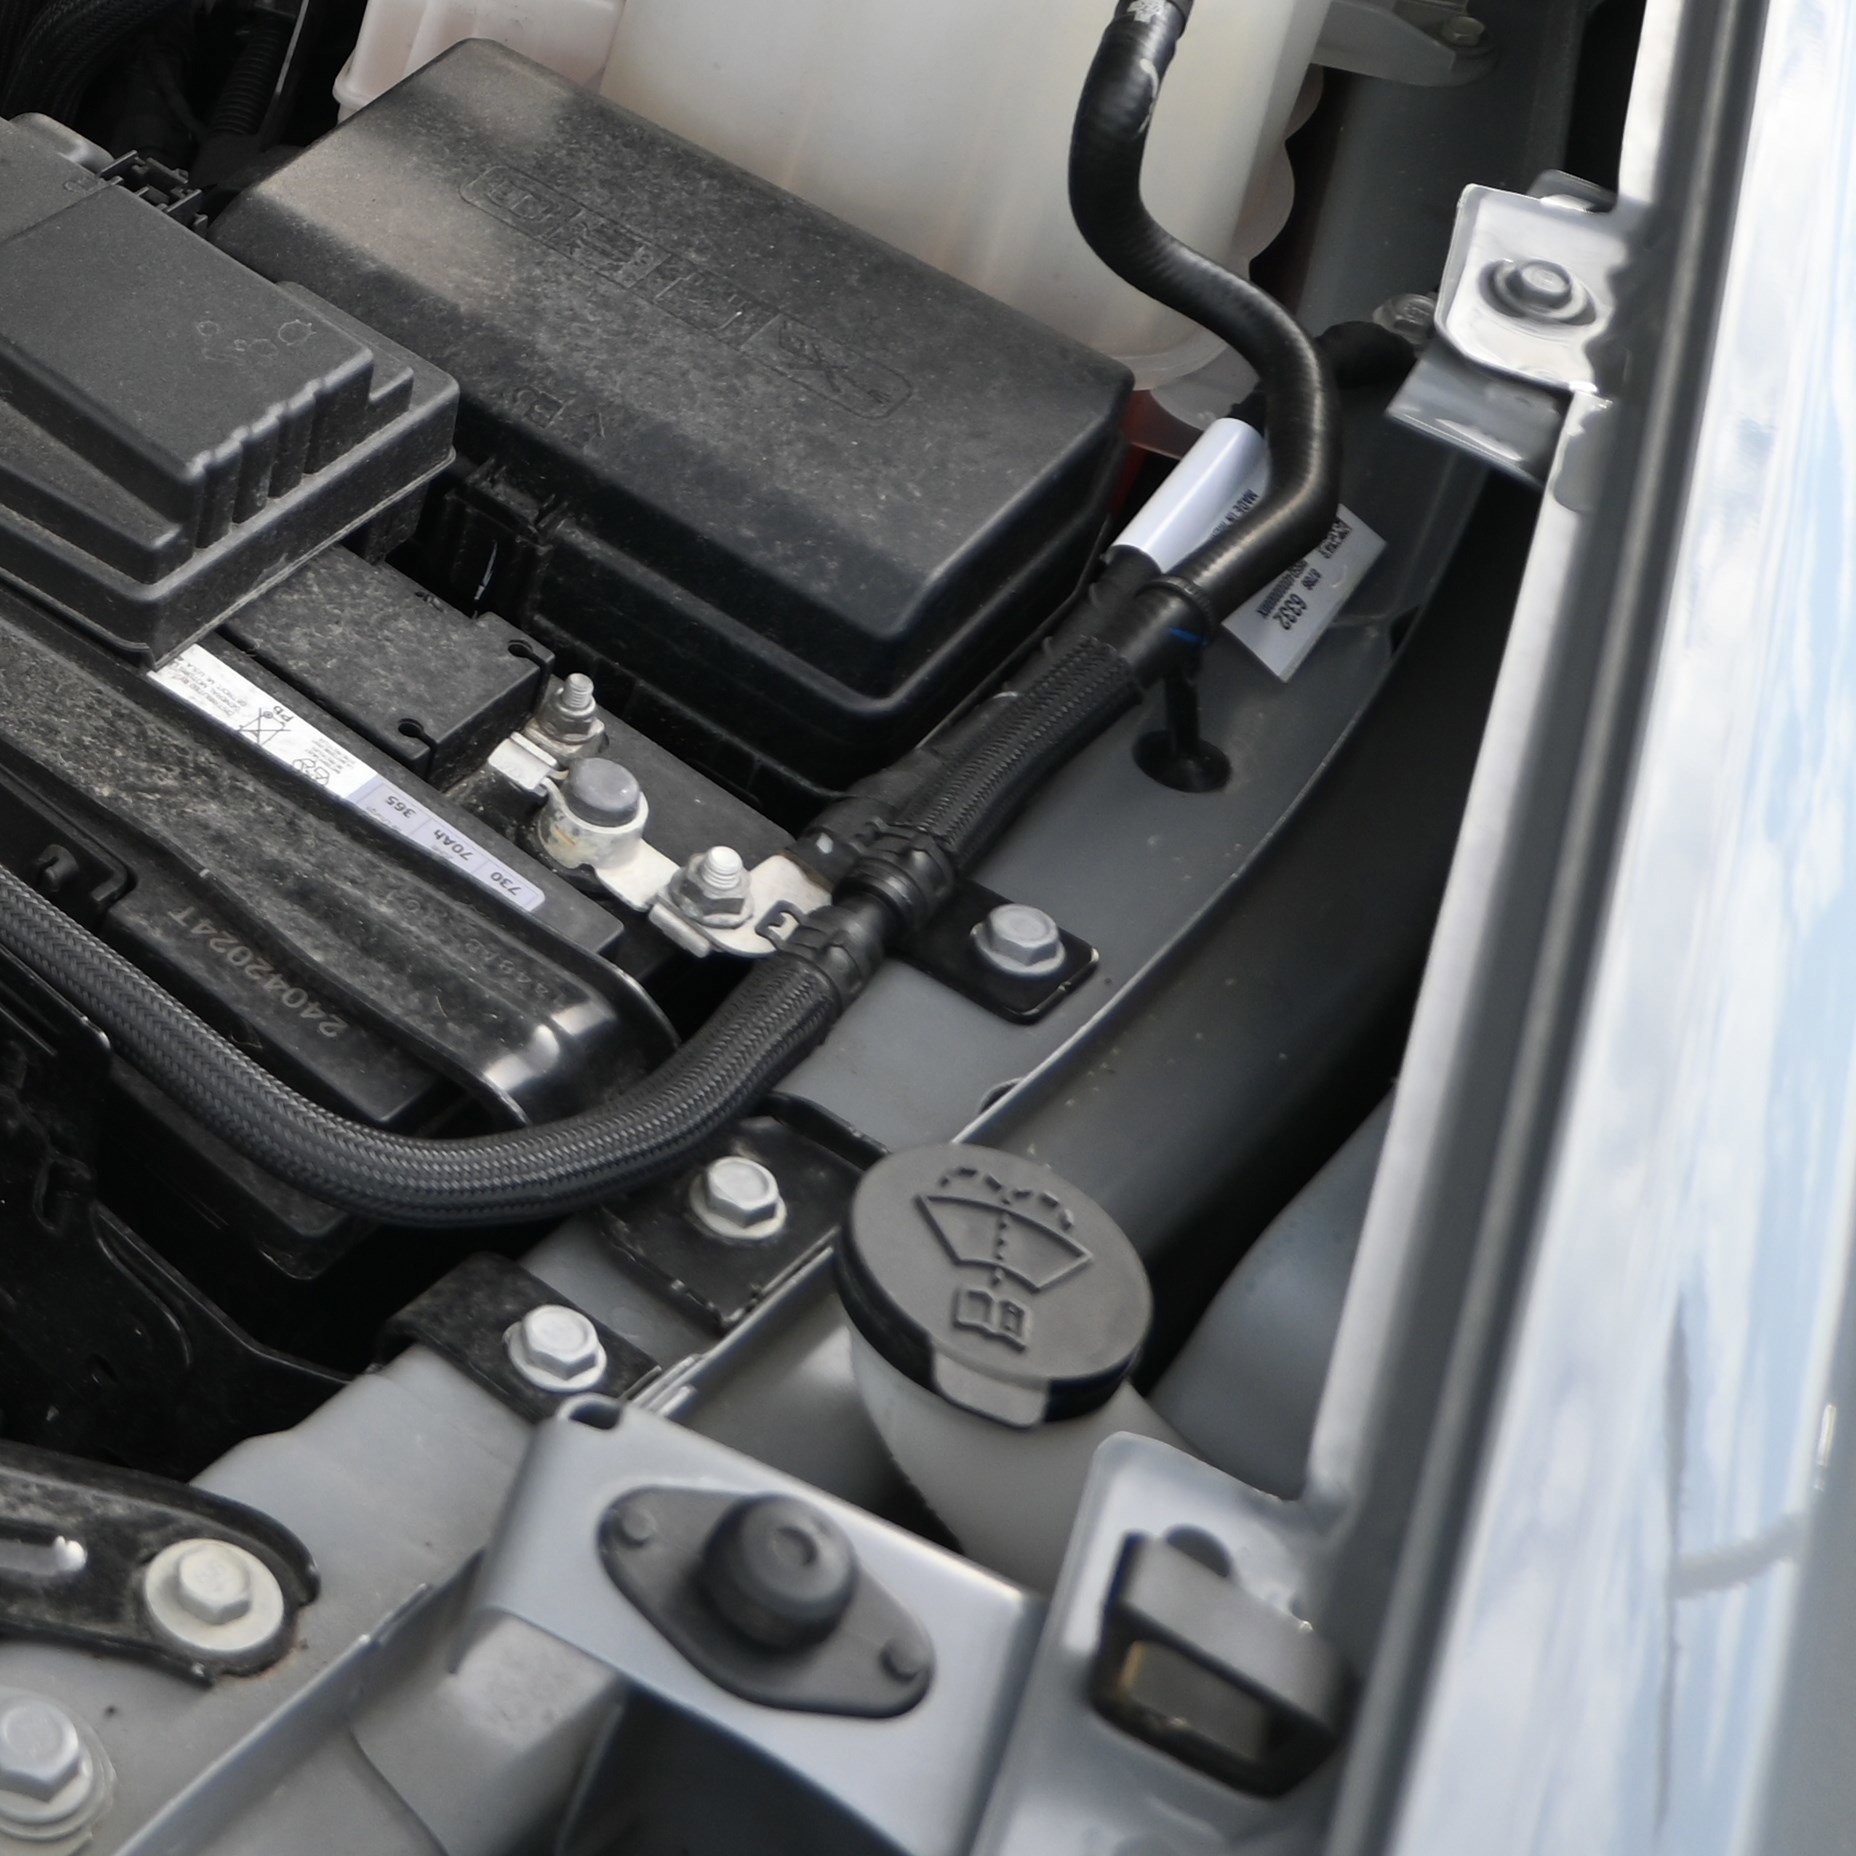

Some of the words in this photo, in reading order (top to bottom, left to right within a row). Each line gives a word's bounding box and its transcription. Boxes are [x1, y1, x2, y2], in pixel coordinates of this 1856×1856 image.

[1272, 593, 1307, 631] 6332
[272, 705, 295, 723] Pb
[385, 795, 417, 820] 365
[433, 828, 474, 862] 70Ah
[490, 871, 523, 896] 730
[168, 906, 348, 1038] 24042024T
